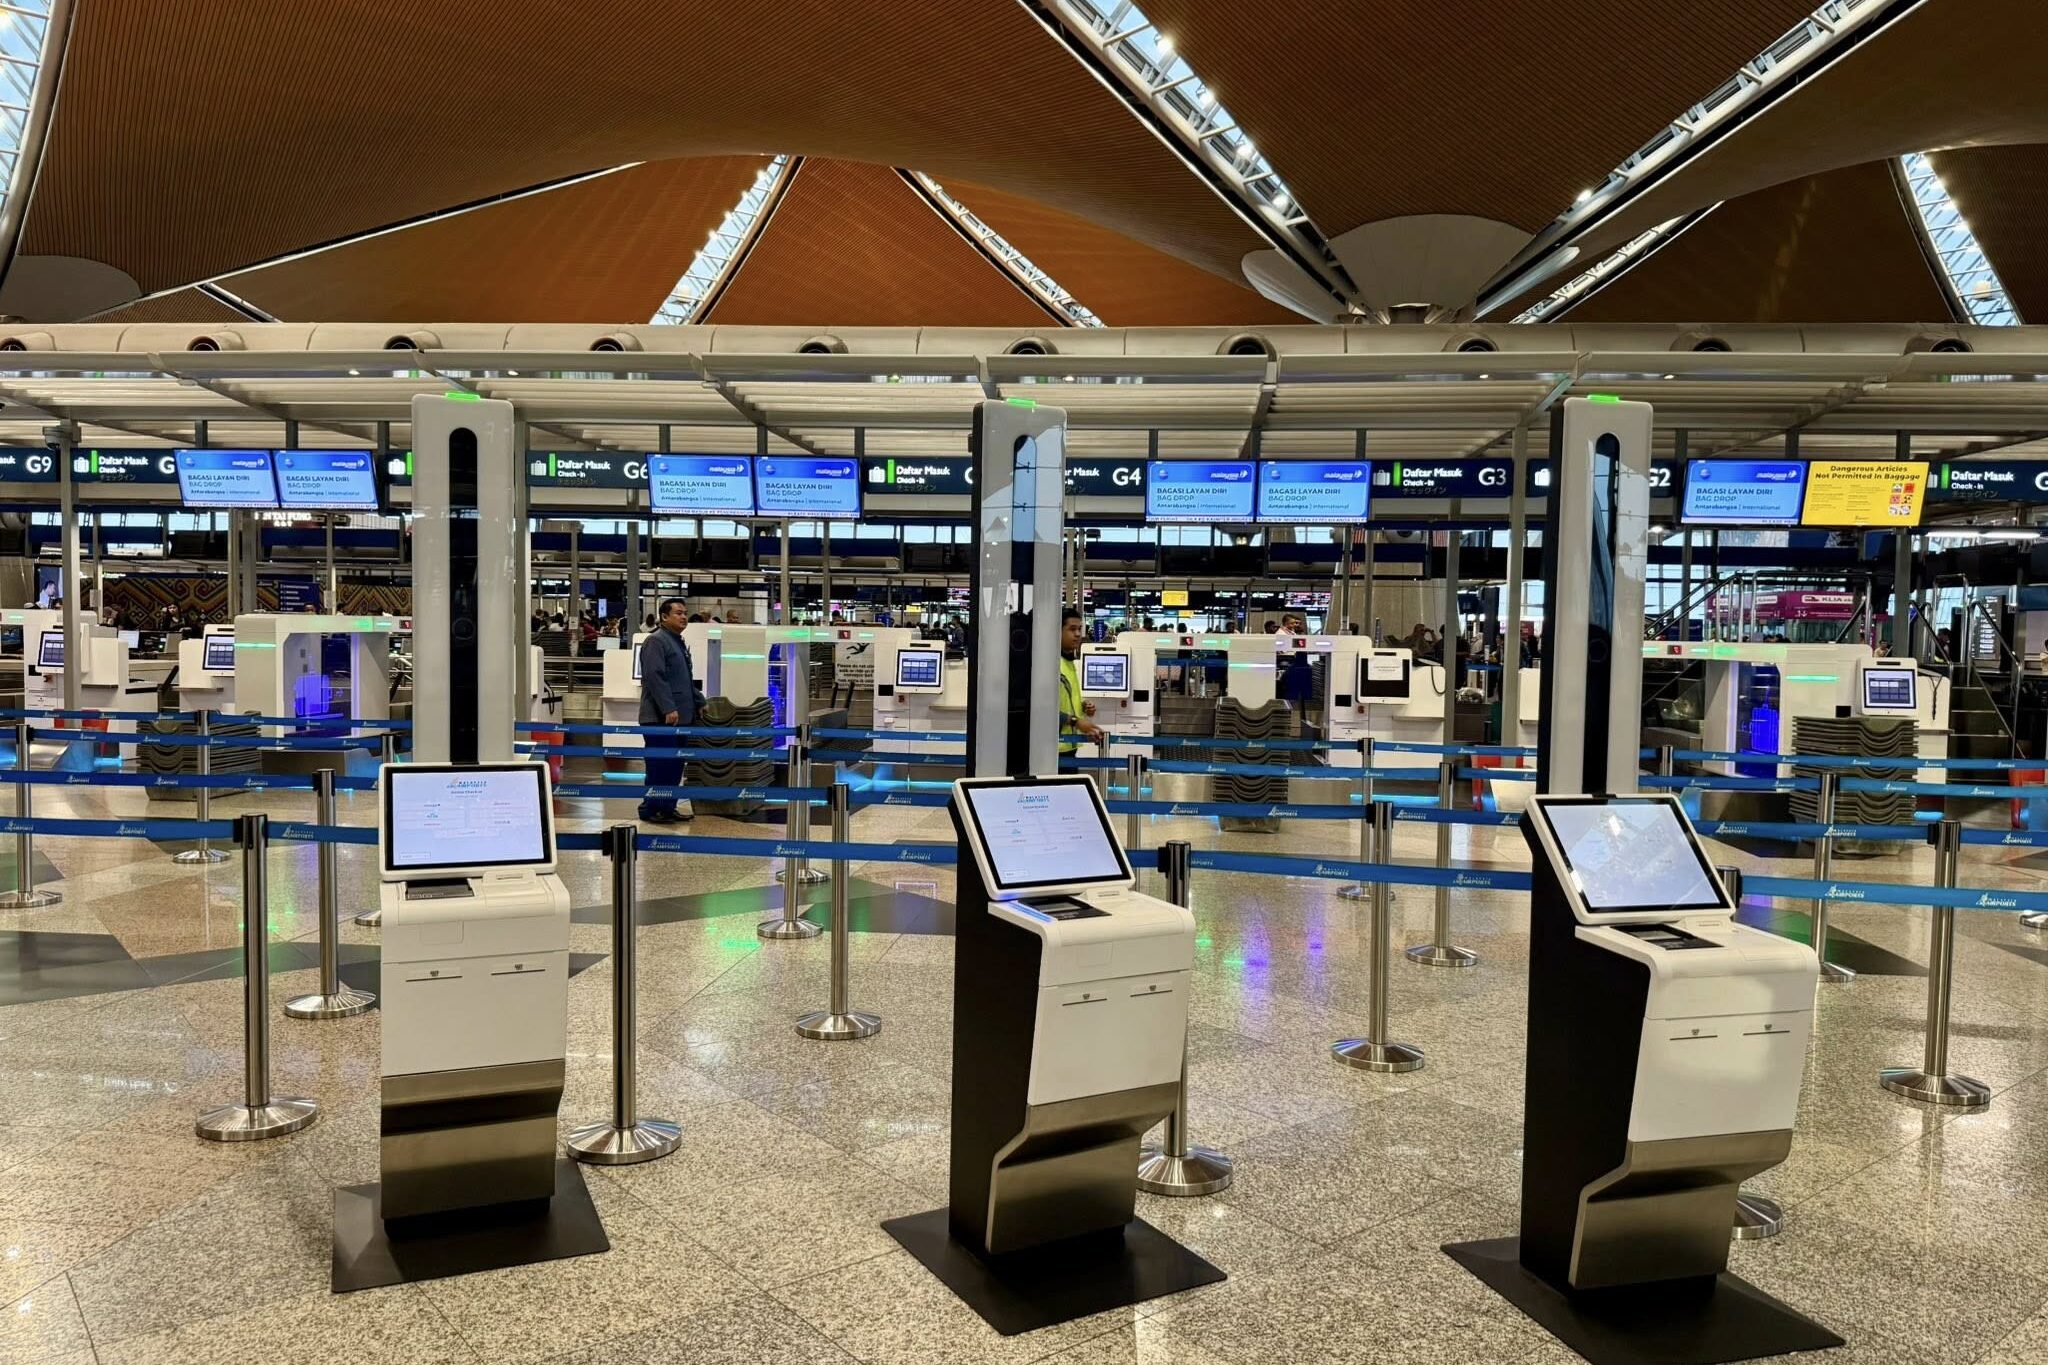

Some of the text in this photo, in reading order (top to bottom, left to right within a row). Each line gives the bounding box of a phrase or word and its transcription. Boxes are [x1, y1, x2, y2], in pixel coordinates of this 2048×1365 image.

[26, 456, 52, 473] G9
[99, 457, 148, 466] Daftar Masuk
[558, 460, 611, 470] Daftar Masuk
[896, 466, 950, 476] Daftar Masuk
[1074, 468, 1099, 476] Masuk
[1403, 468, 1462, 477] Daftar Masuk
[1951, 471, 2014, 481] Daftar Masuk
[1113, 467, 1141, 486] G4
[1478, 468, 1507, 486] G3
[1885, 473, 1921, 481] Baggage
